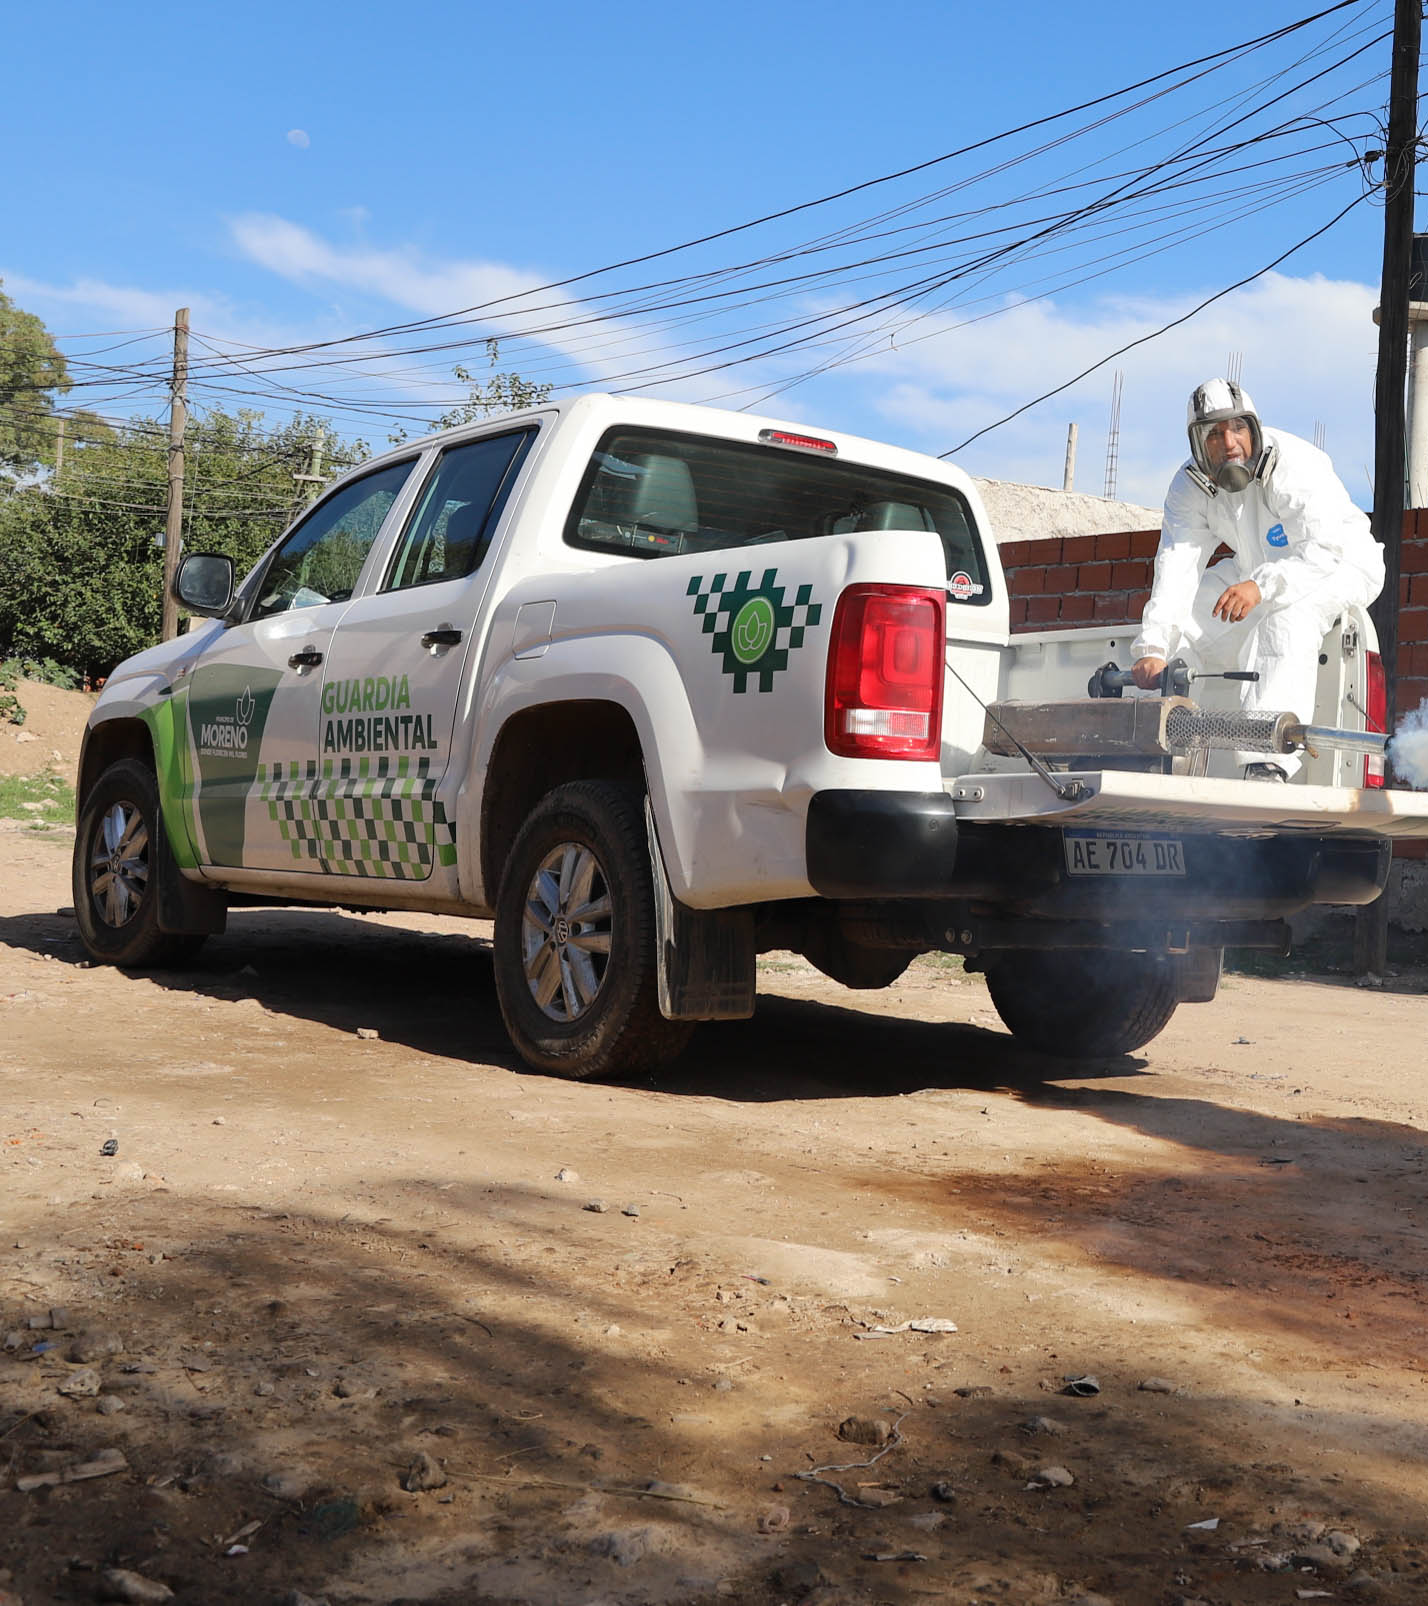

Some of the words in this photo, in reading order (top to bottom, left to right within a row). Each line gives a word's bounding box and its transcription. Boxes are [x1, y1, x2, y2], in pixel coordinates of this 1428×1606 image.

[322, 674, 411, 715] GUARDIA
[200, 723, 248, 749] MORENO
[323, 714, 438, 753] AMBIENTAL
[1073, 840, 1100, 870] AE
[1106, 841, 1147, 870] 704
[1153, 842, 1181, 871] DR
